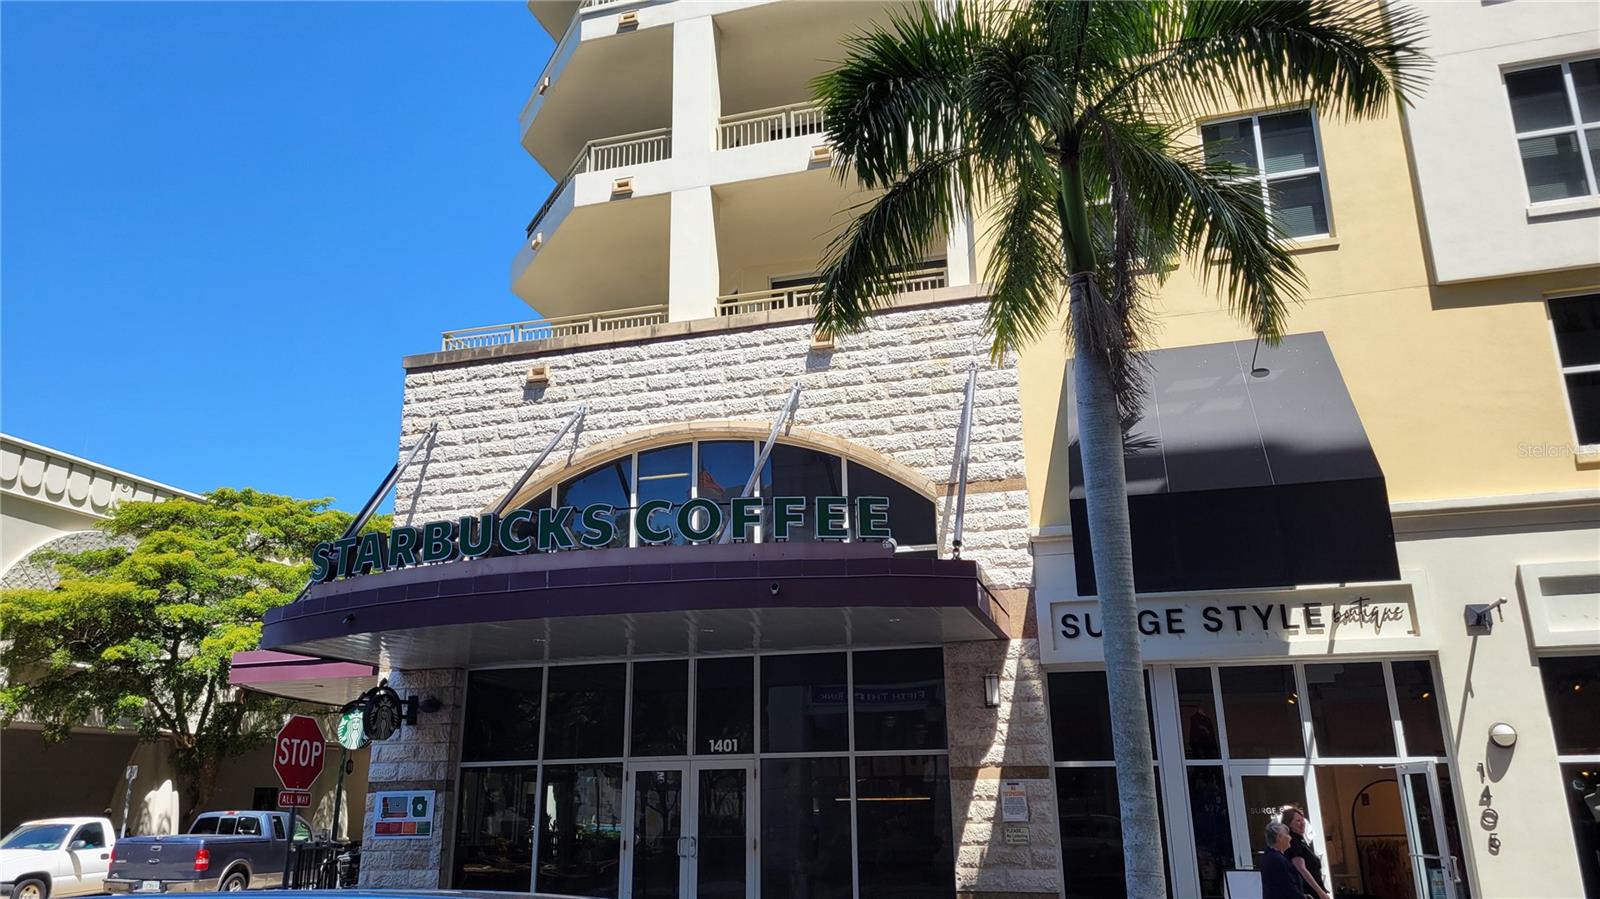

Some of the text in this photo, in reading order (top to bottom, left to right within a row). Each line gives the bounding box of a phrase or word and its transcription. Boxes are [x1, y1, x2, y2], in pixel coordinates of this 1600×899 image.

[311, 496, 891, 583] STARBUCKS COFFEE
[1061, 597, 1404, 639] SUGE STYLE boutique
[278, 737, 322, 767] STOP
[709, 739, 738, 752] 1401
[281, 794, 310, 804] ALL WAY
[1250, 807, 1276, 815] SURGE
